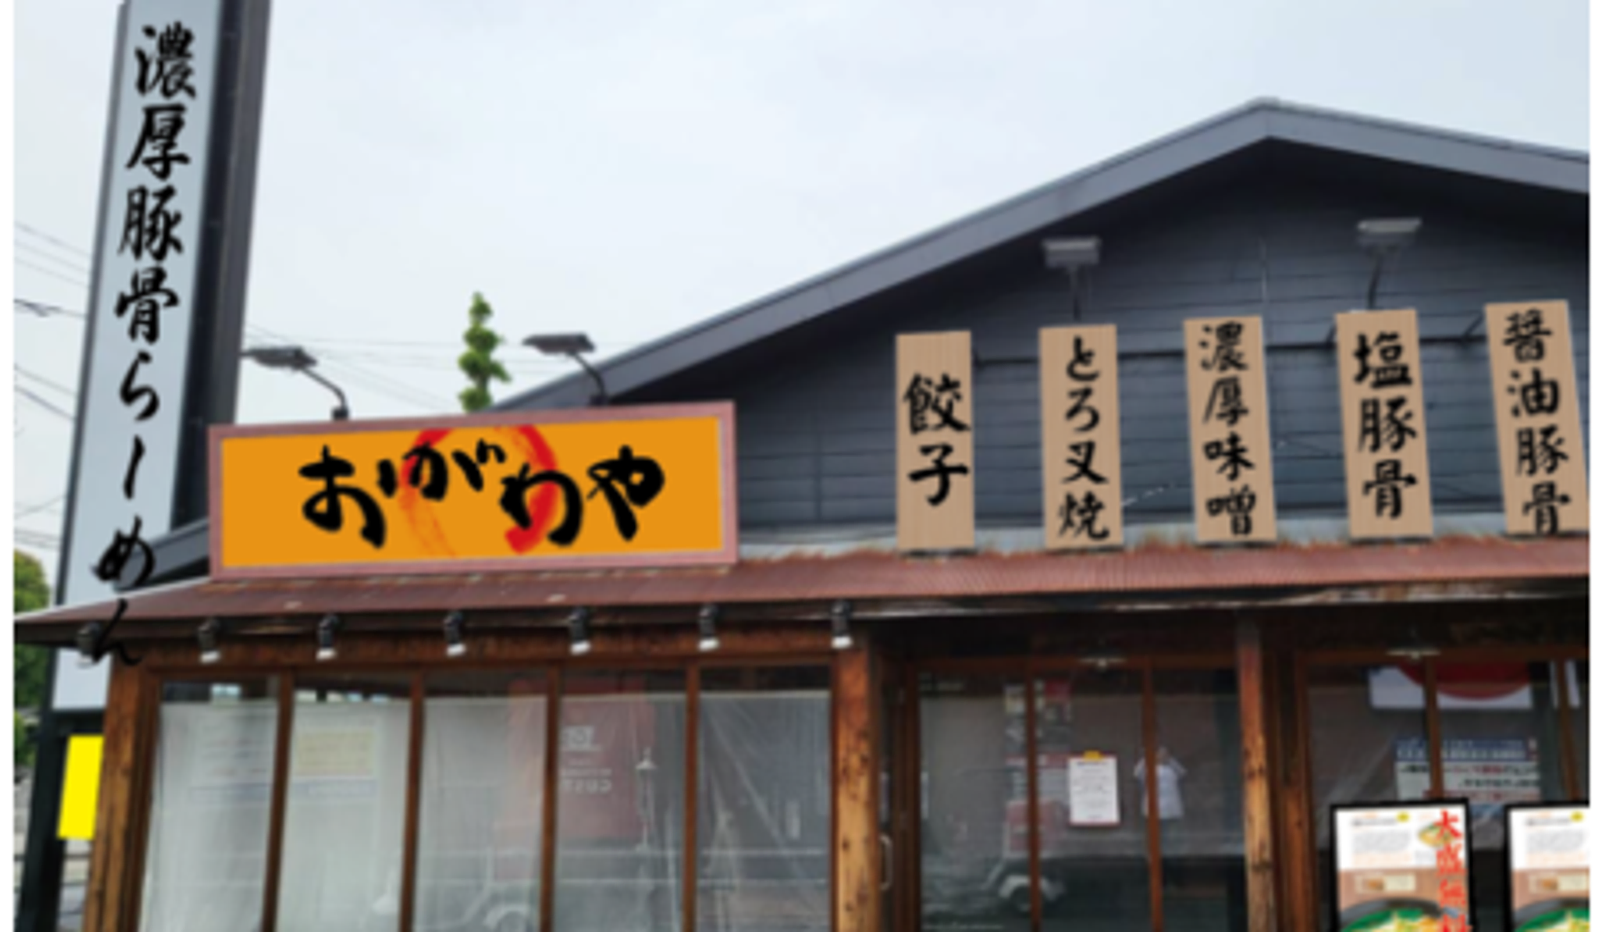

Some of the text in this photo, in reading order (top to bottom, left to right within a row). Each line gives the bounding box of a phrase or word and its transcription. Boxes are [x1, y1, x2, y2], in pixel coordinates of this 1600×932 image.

[90, 21, 197, 667] 濃厚豚骨らーめん
[298, 429, 665, 549] おがわや
[903, 373, 971, 506] 餃子
[1353, 331, 1418, 519] 塩豚骨
